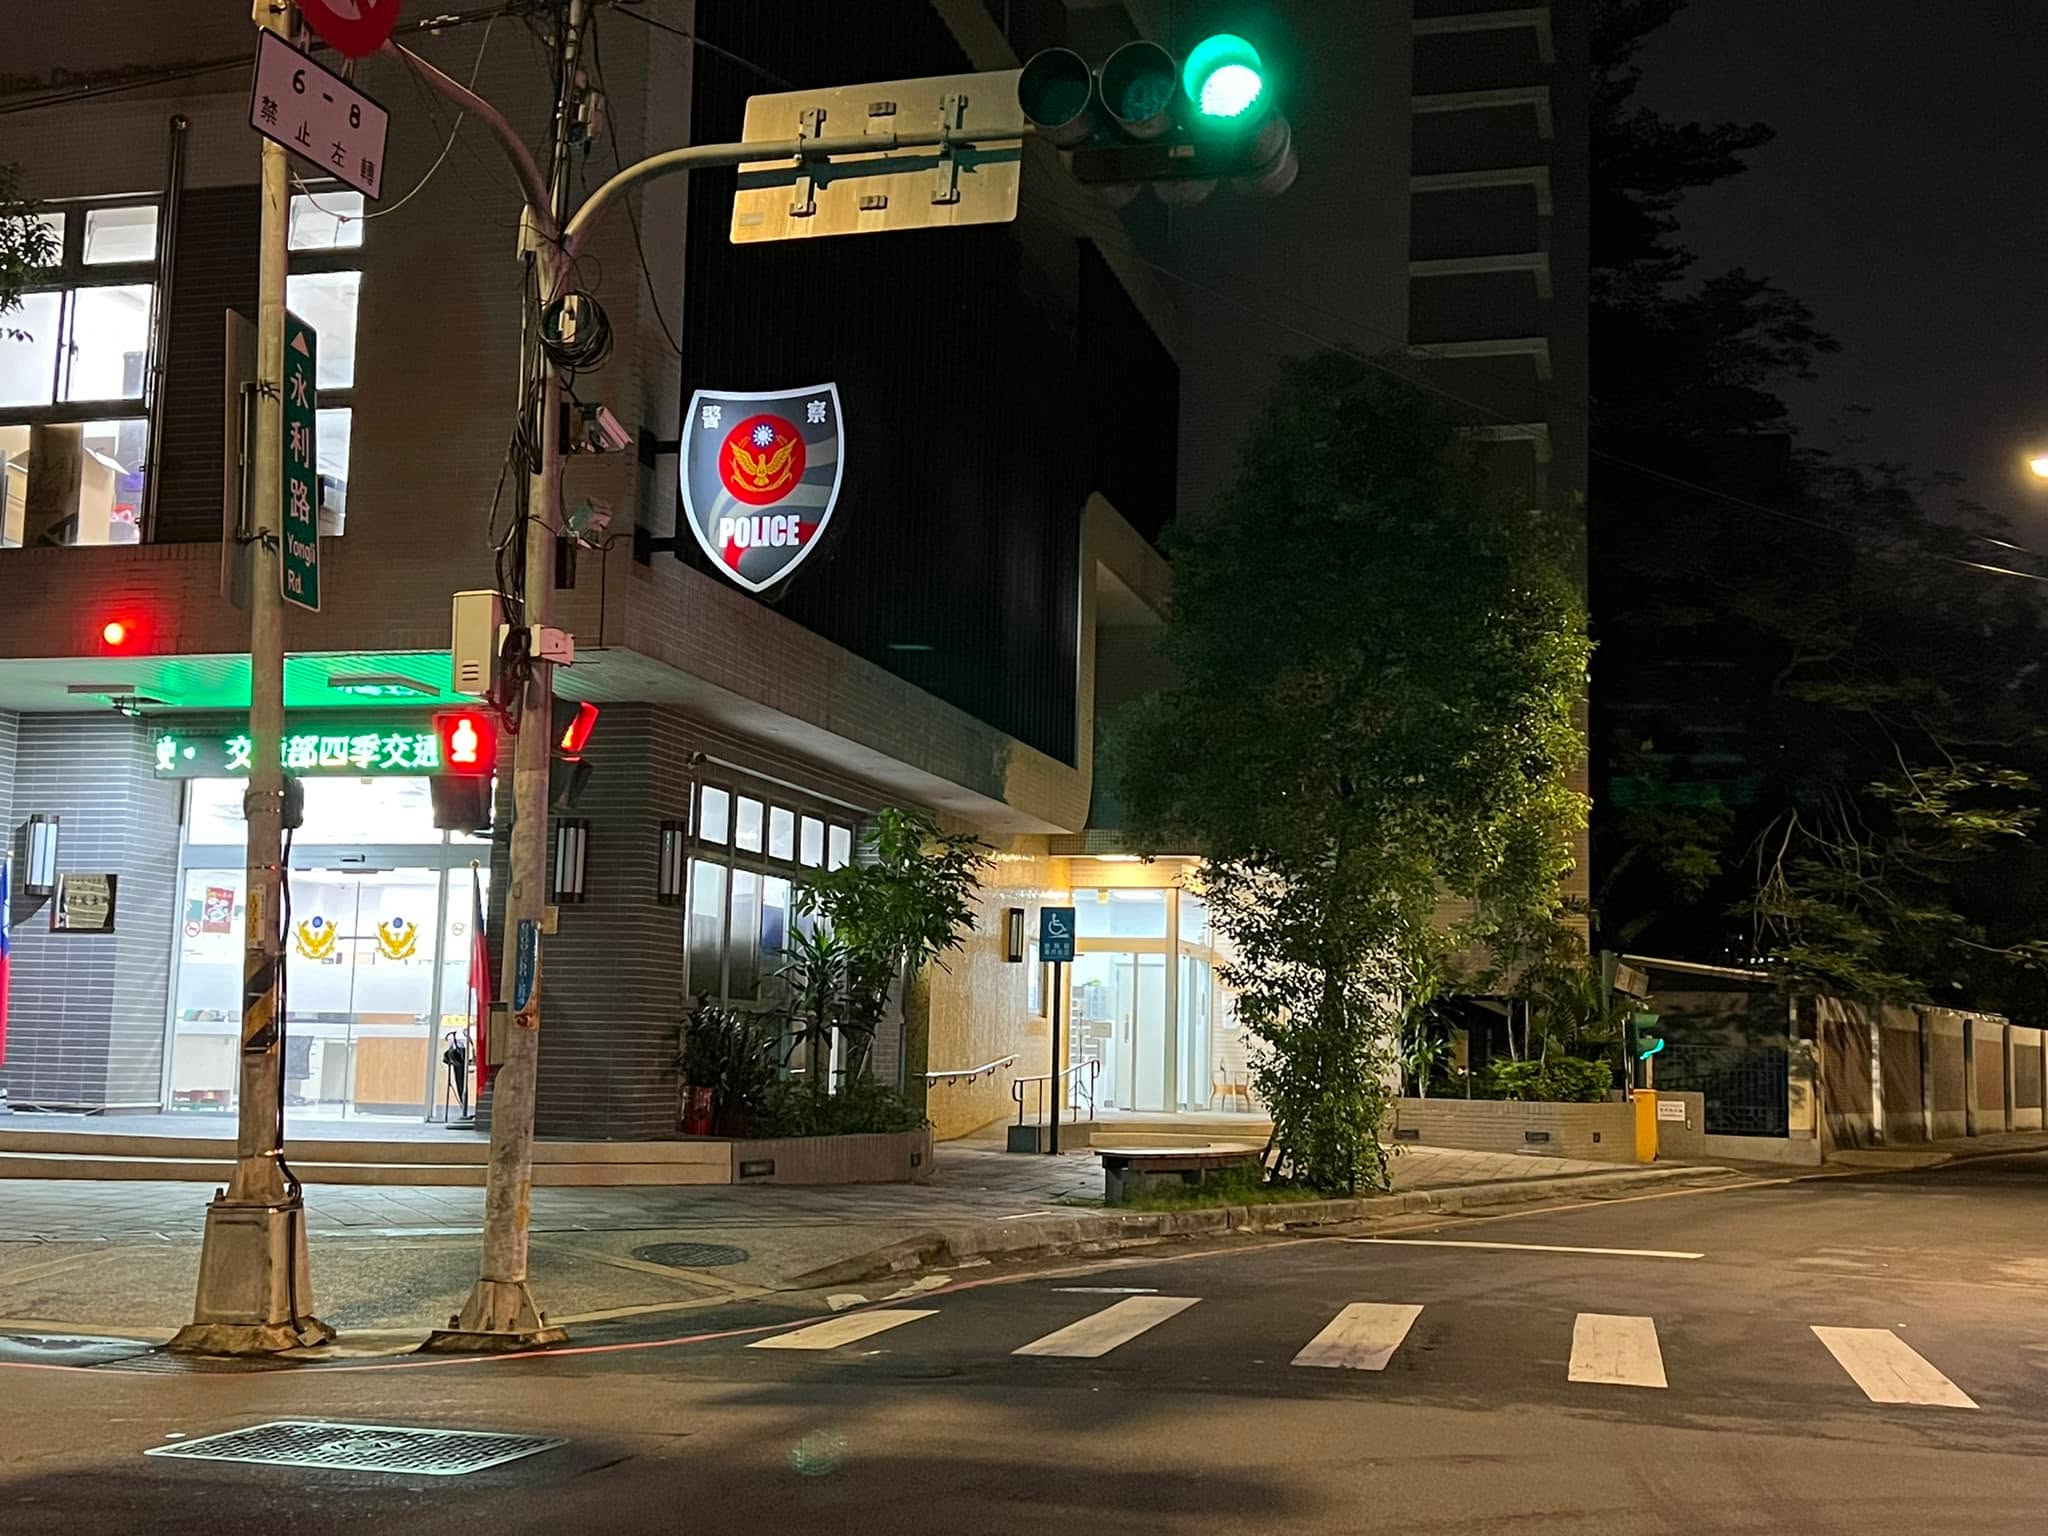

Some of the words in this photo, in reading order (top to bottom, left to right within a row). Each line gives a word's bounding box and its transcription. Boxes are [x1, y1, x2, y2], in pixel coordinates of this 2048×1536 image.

[260, 95, 375, 187] 禁止左轉
[289, 362, 310, 524] 永利路
[287, 531, 317, 568] Yongli
[718, 514, 801, 549] POLICE
[223, 734, 440, 770] 交部四季交通
